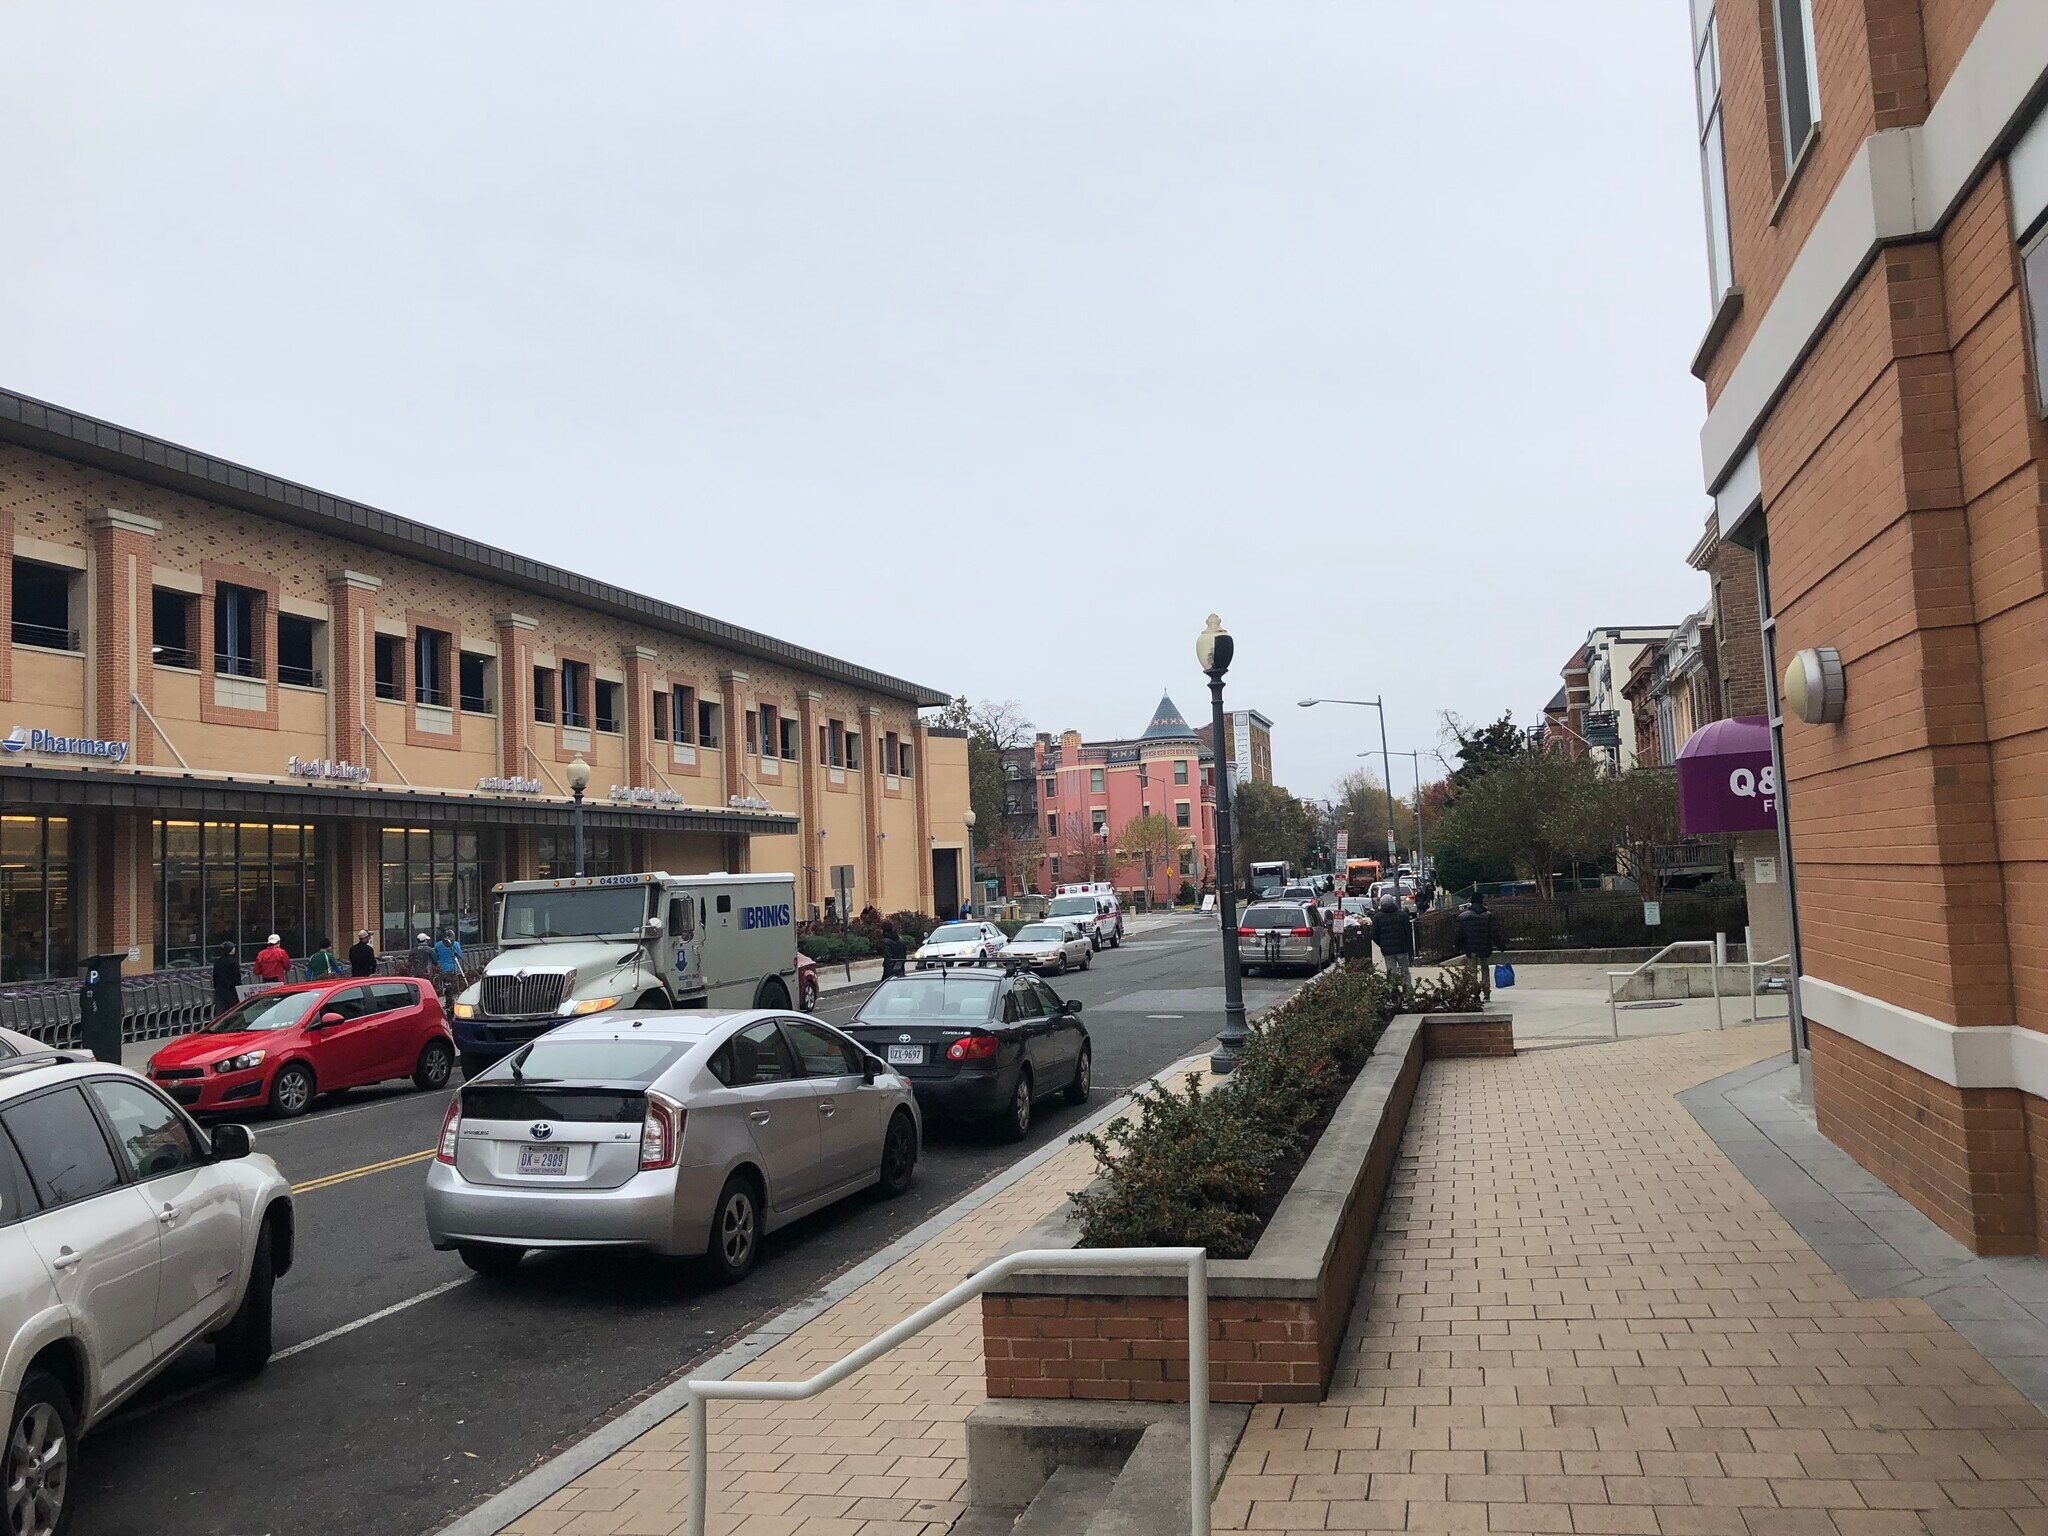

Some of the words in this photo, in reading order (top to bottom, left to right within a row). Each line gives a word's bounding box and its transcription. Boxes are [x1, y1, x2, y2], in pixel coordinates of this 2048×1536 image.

[31, 729, 128, 763] Pharmacy
[292, 756, 325, 776] fresh
[329, 760, 372, 783] bakery
[1237, 739, 1249, 782] LEASING
[600, 876, 639, 885] 042009
[747, 904, 790, 929] BRINKS
[90, 970, 99, 984] P
[890, 1050, 921, 1060] UZX-9697
[521, 1153, 533, 1167] DK
[541, 1153, 564, 1167] 2989
